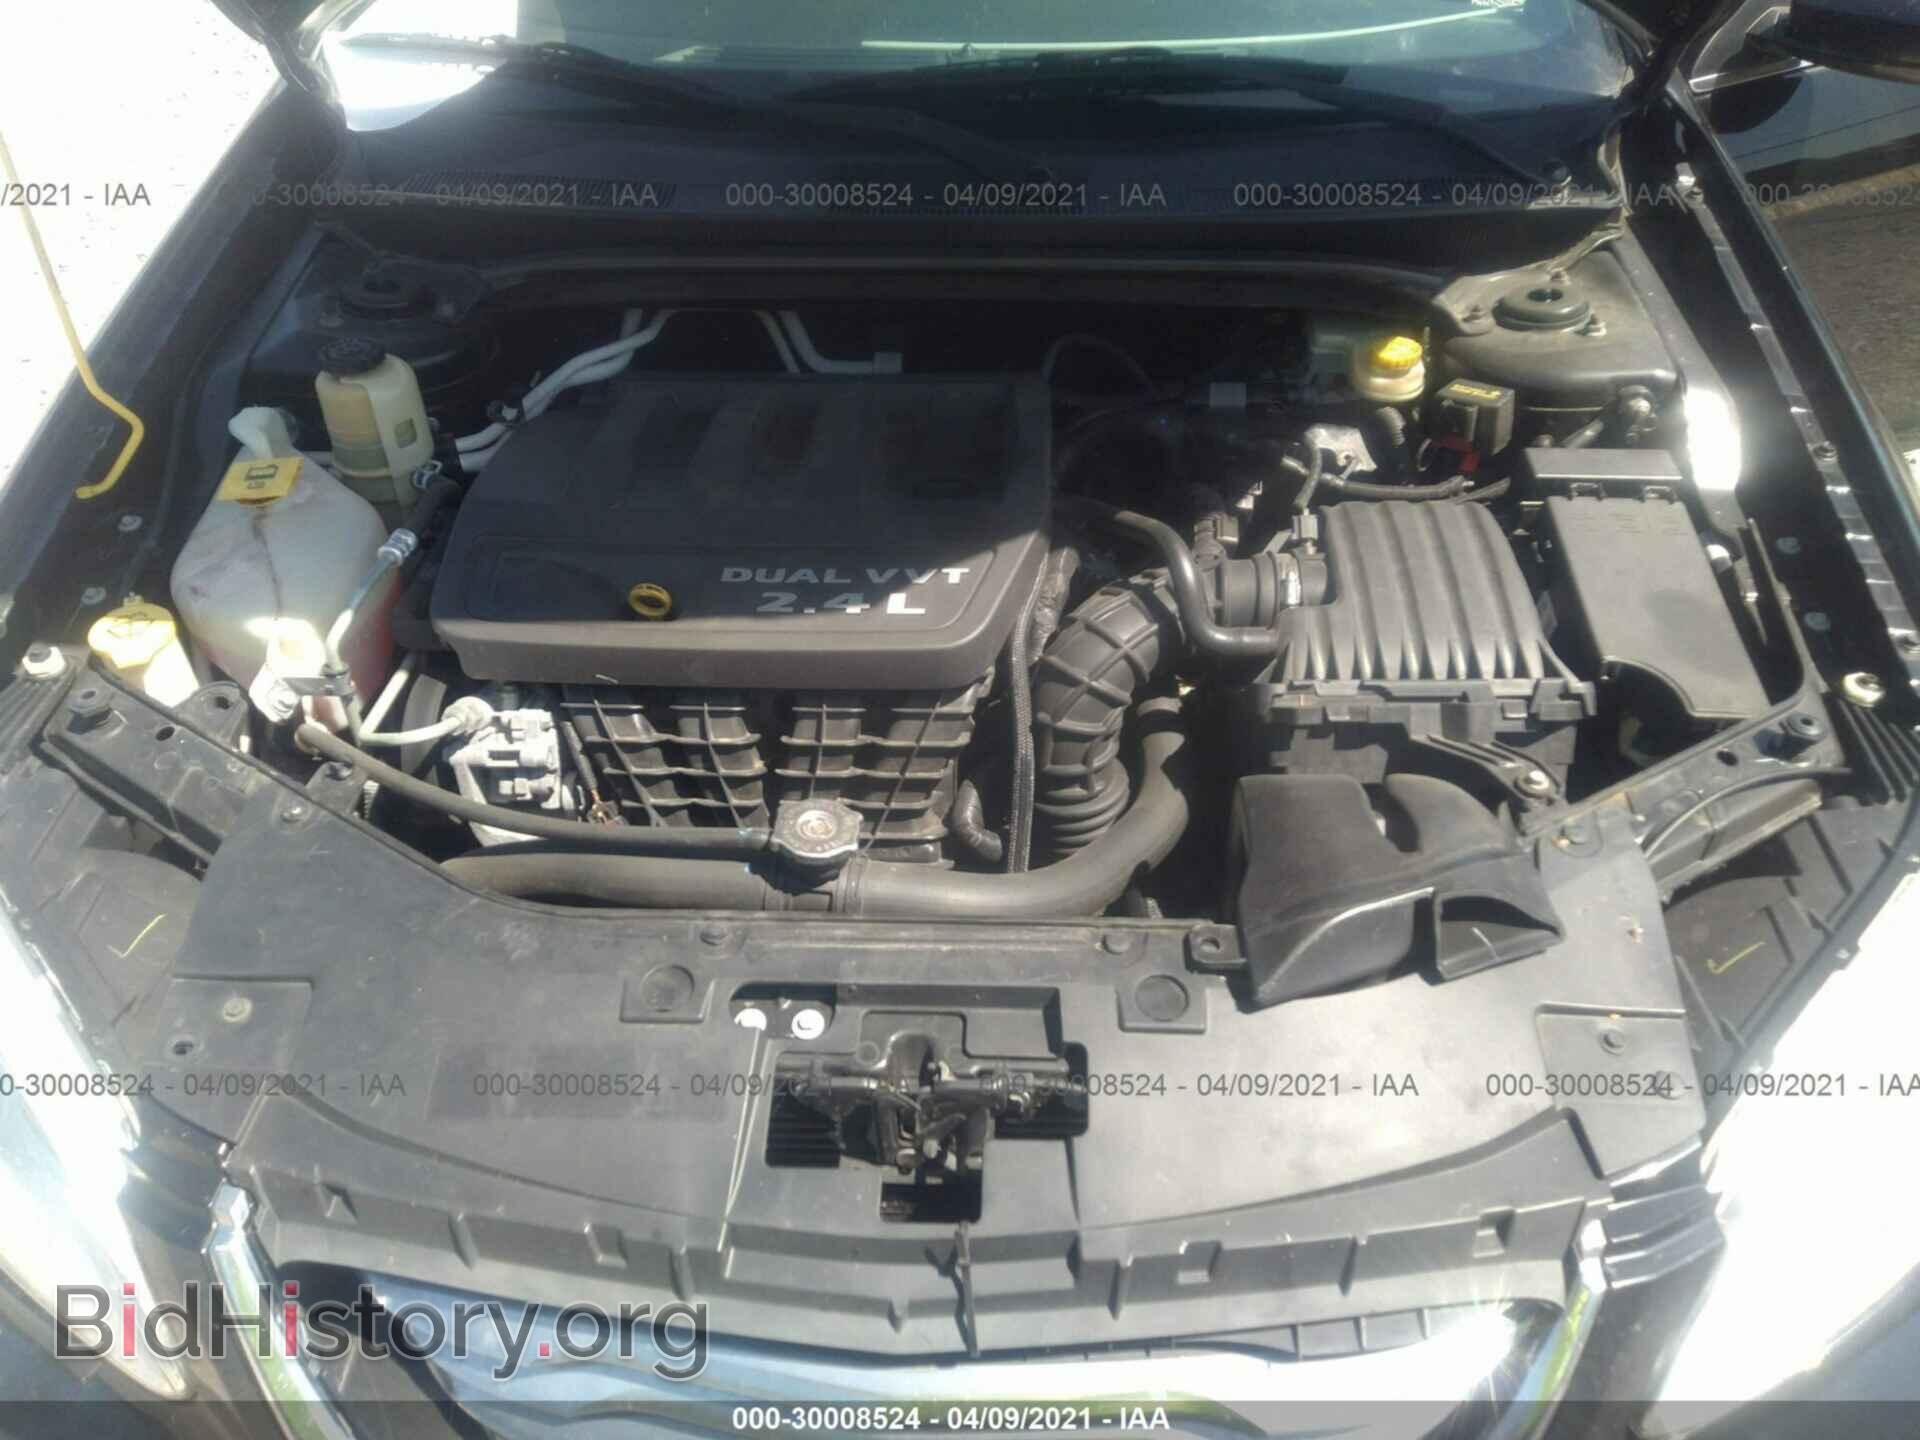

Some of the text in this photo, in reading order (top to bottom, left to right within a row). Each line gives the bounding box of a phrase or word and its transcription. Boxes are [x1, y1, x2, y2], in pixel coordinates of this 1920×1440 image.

[720, 567, 971, 584] DUAL VVT
[756, 592, 871, 614] 2.4
